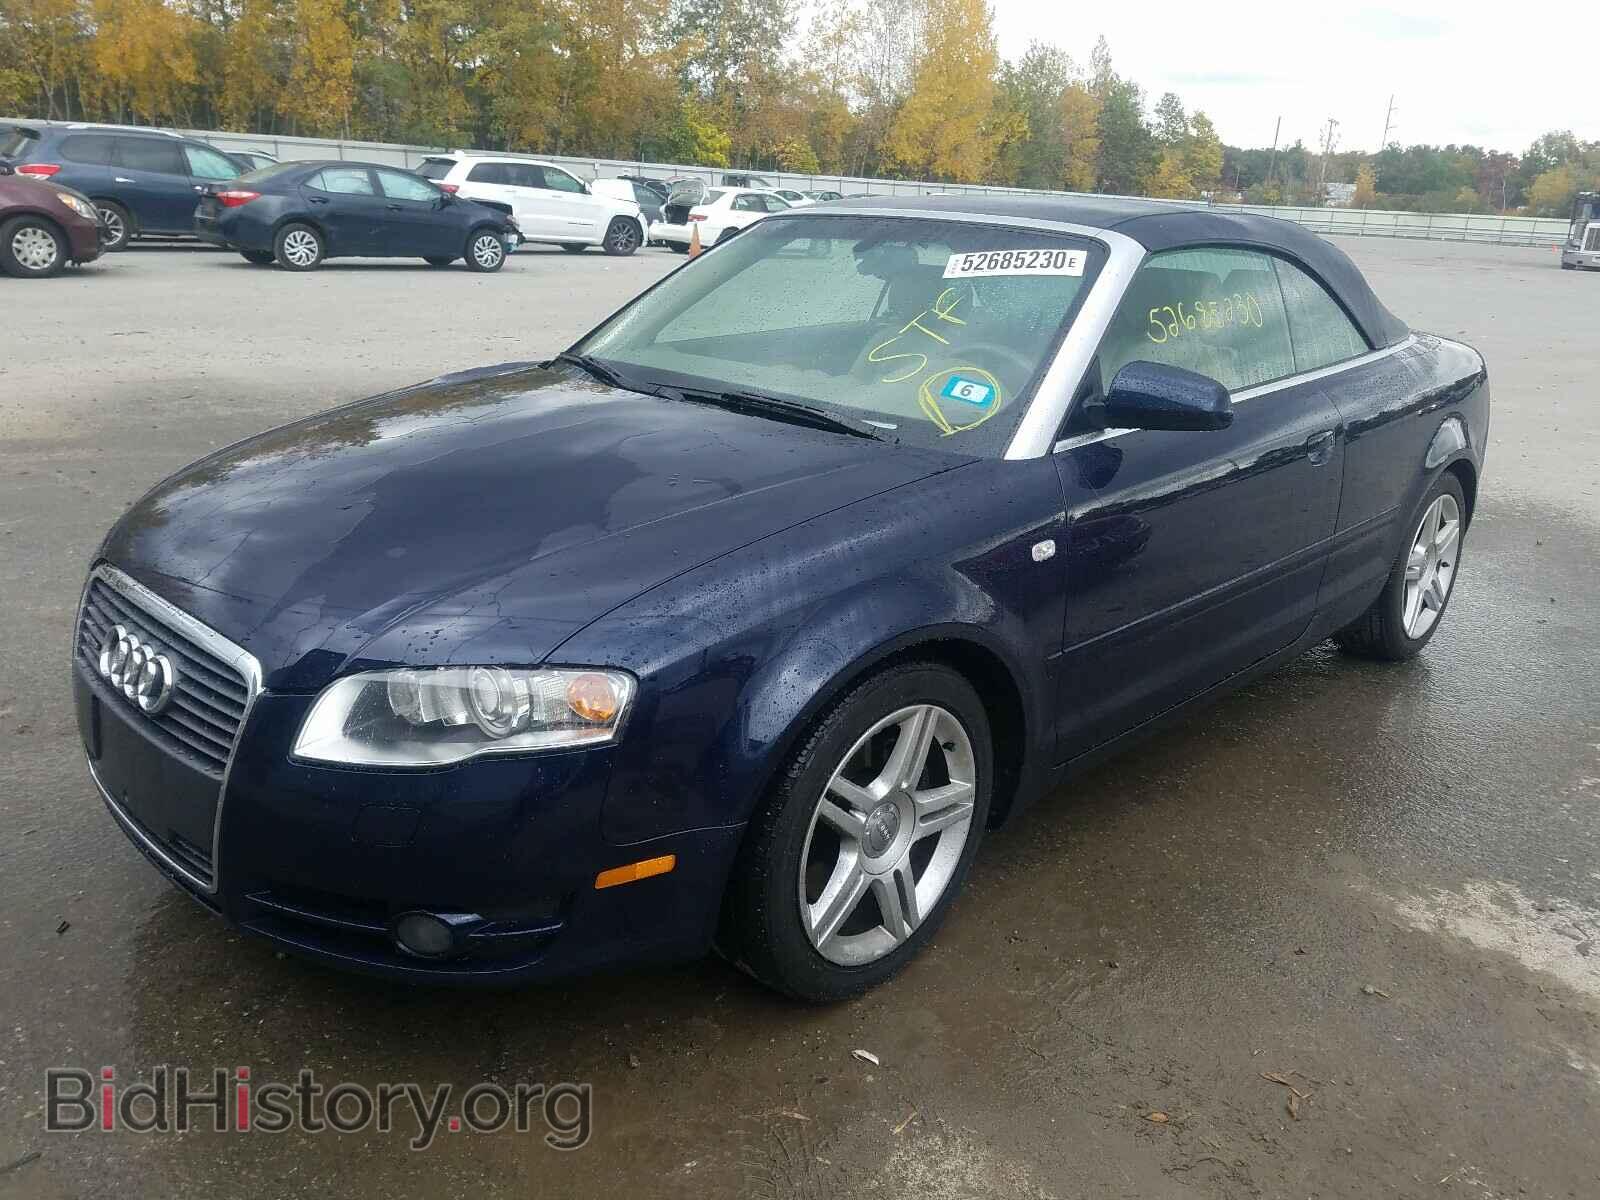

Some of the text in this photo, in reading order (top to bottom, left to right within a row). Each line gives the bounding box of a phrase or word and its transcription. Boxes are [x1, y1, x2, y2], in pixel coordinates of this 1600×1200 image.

[961, 251, 1067, 272] 52685230
[1146, 292, 1263, 343] 52685230
[960, 384, 974, 397] 6
